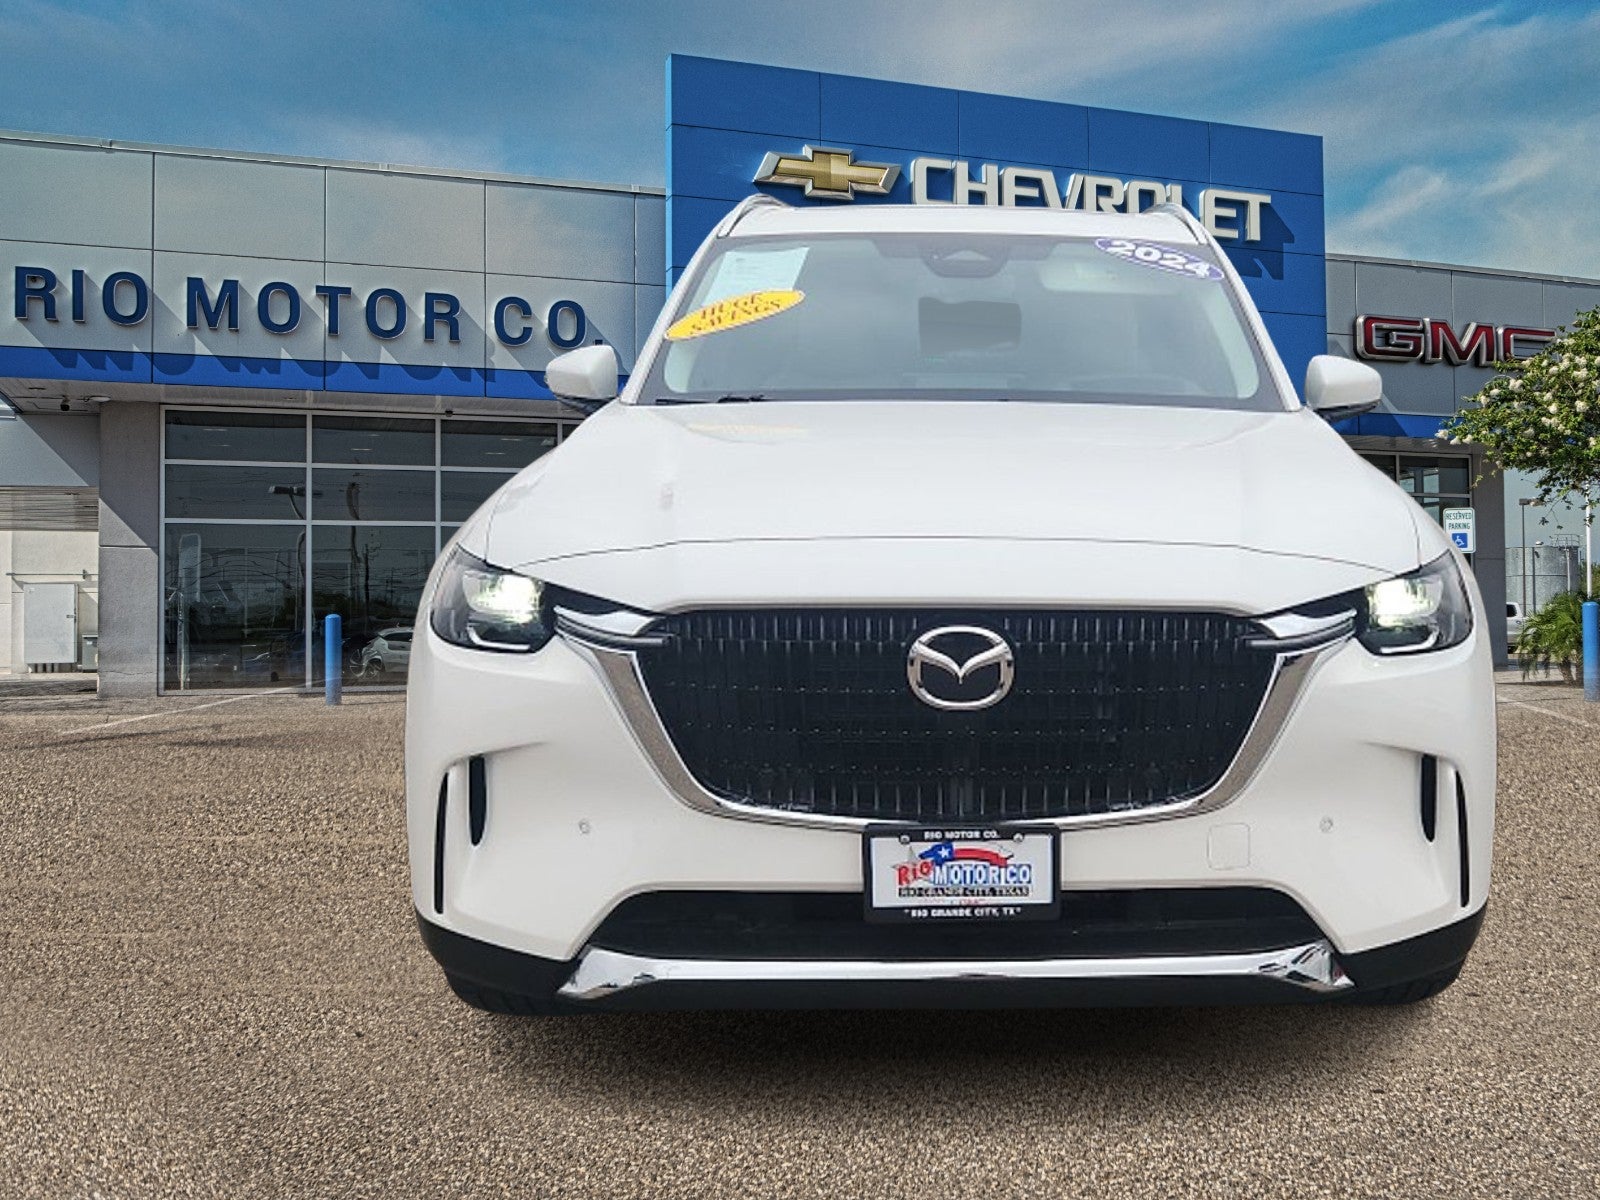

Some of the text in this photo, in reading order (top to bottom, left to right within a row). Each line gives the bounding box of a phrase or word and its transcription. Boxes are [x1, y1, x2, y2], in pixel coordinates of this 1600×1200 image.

[1105, 240, 1210, 278] 2024
[14, 265, 150, 325] RIO
[186, 276, 461, 343] MOTOR
[1356, 314, 1557, 367] GMC
[1446, 512, 1471, 520] RESERVED
[1448, 522, 1470, 530] PARKING
[924, 831, 942, 839] RIO
[945, 831, 980, 839] MOTOR
